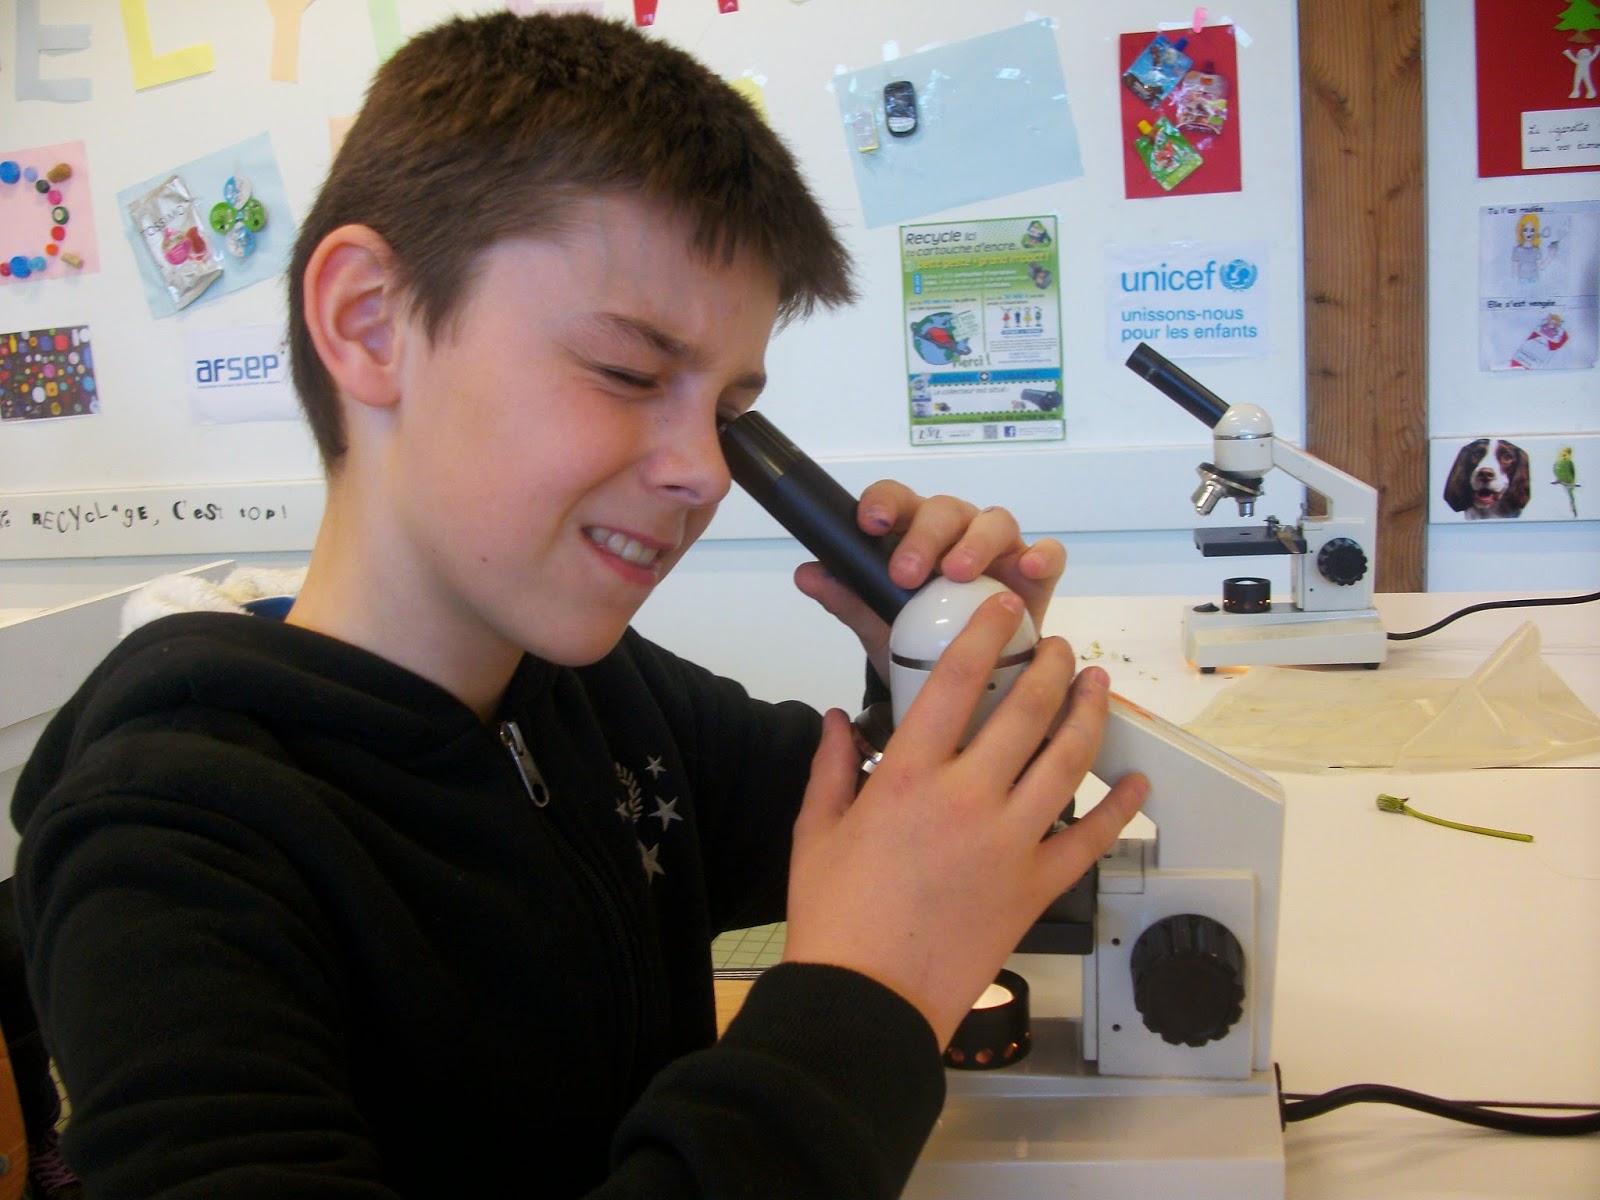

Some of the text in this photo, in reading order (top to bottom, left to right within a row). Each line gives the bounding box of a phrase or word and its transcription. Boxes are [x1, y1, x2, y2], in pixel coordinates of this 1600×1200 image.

[905, 230, 962, 245] Recycle
[917, 244, 972, 257] cartouche
[1121, 260, 1216, 292] unicef
[1121, 307, 1244, 322] unissons-nous
[1121, 323, 1257, 342] pour les enfants
[196, 354, 279, 383] afsep
